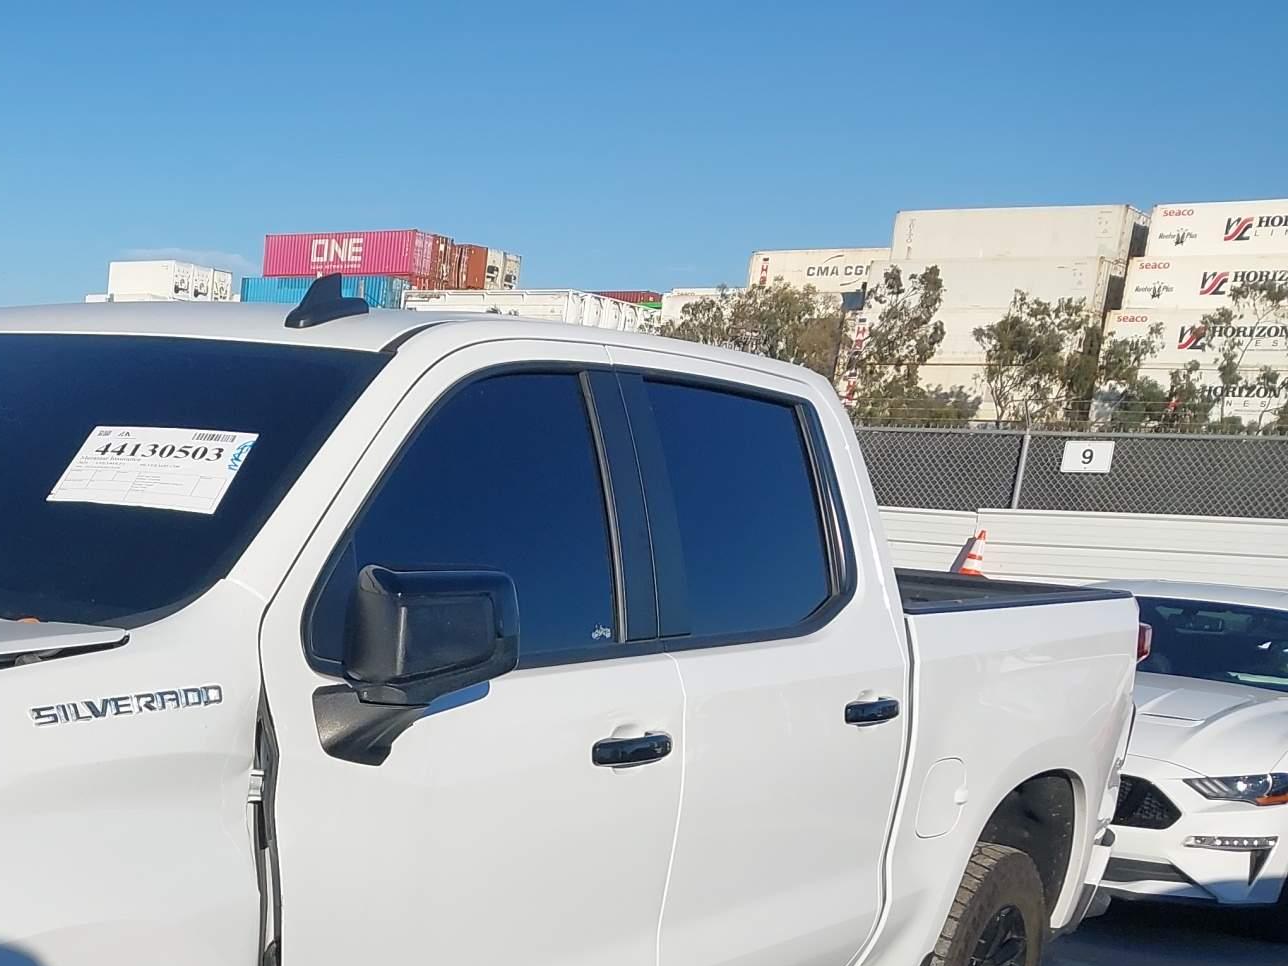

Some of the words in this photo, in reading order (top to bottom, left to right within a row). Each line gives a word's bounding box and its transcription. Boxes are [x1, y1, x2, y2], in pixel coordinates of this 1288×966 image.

[1162, 208, 1195, 216] seaco
[311, 237, 364, 263] ONE
[806, 266, 839, 276] CMA
[1139, 262, 1170, 270] seaco
[1116, 315, 1148, 323] seaco
[94, 442, 225, 462] 44130503
[1081, 448, 1094, 465] 9
[31, 684, 224, 726] SILVERADO
